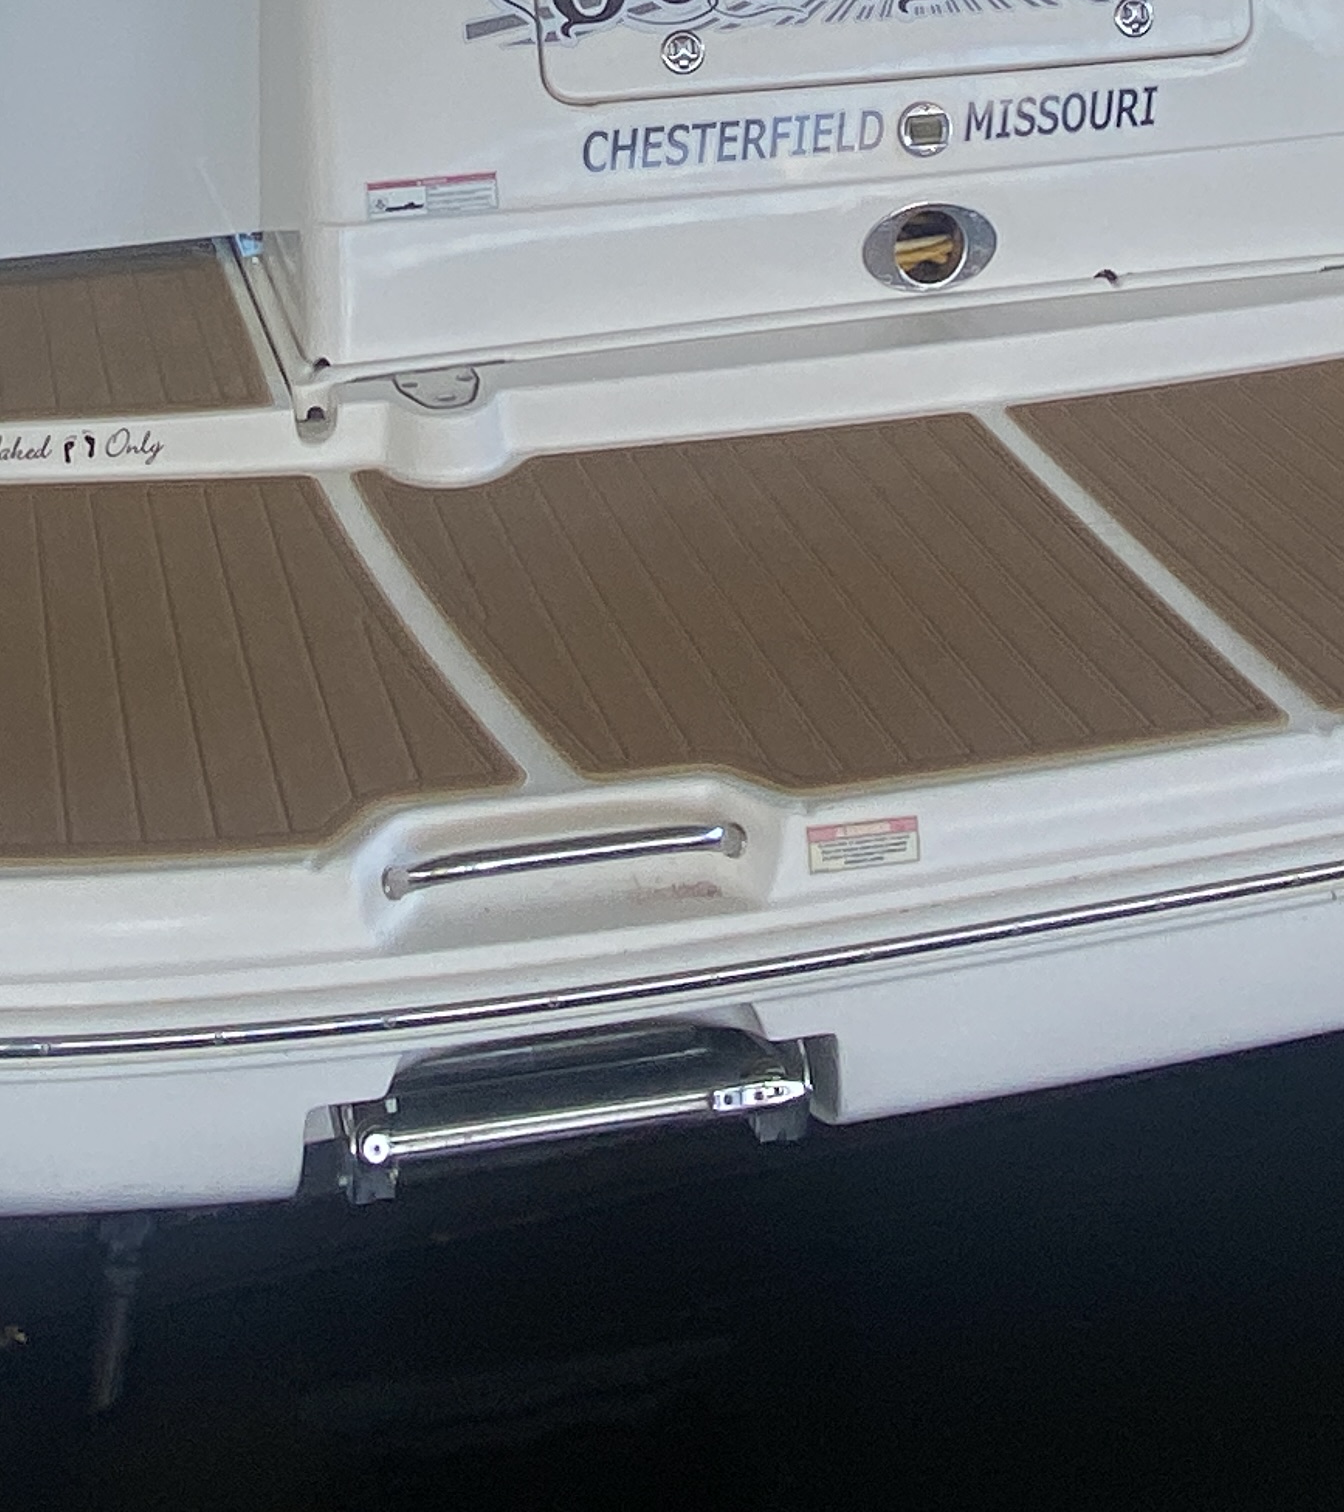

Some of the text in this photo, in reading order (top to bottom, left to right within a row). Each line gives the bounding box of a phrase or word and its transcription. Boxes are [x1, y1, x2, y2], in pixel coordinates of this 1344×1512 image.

[582, 86, 1158, 173] CHESTERFIELD MISSOURI
[105, 427, 165, 466] Only
